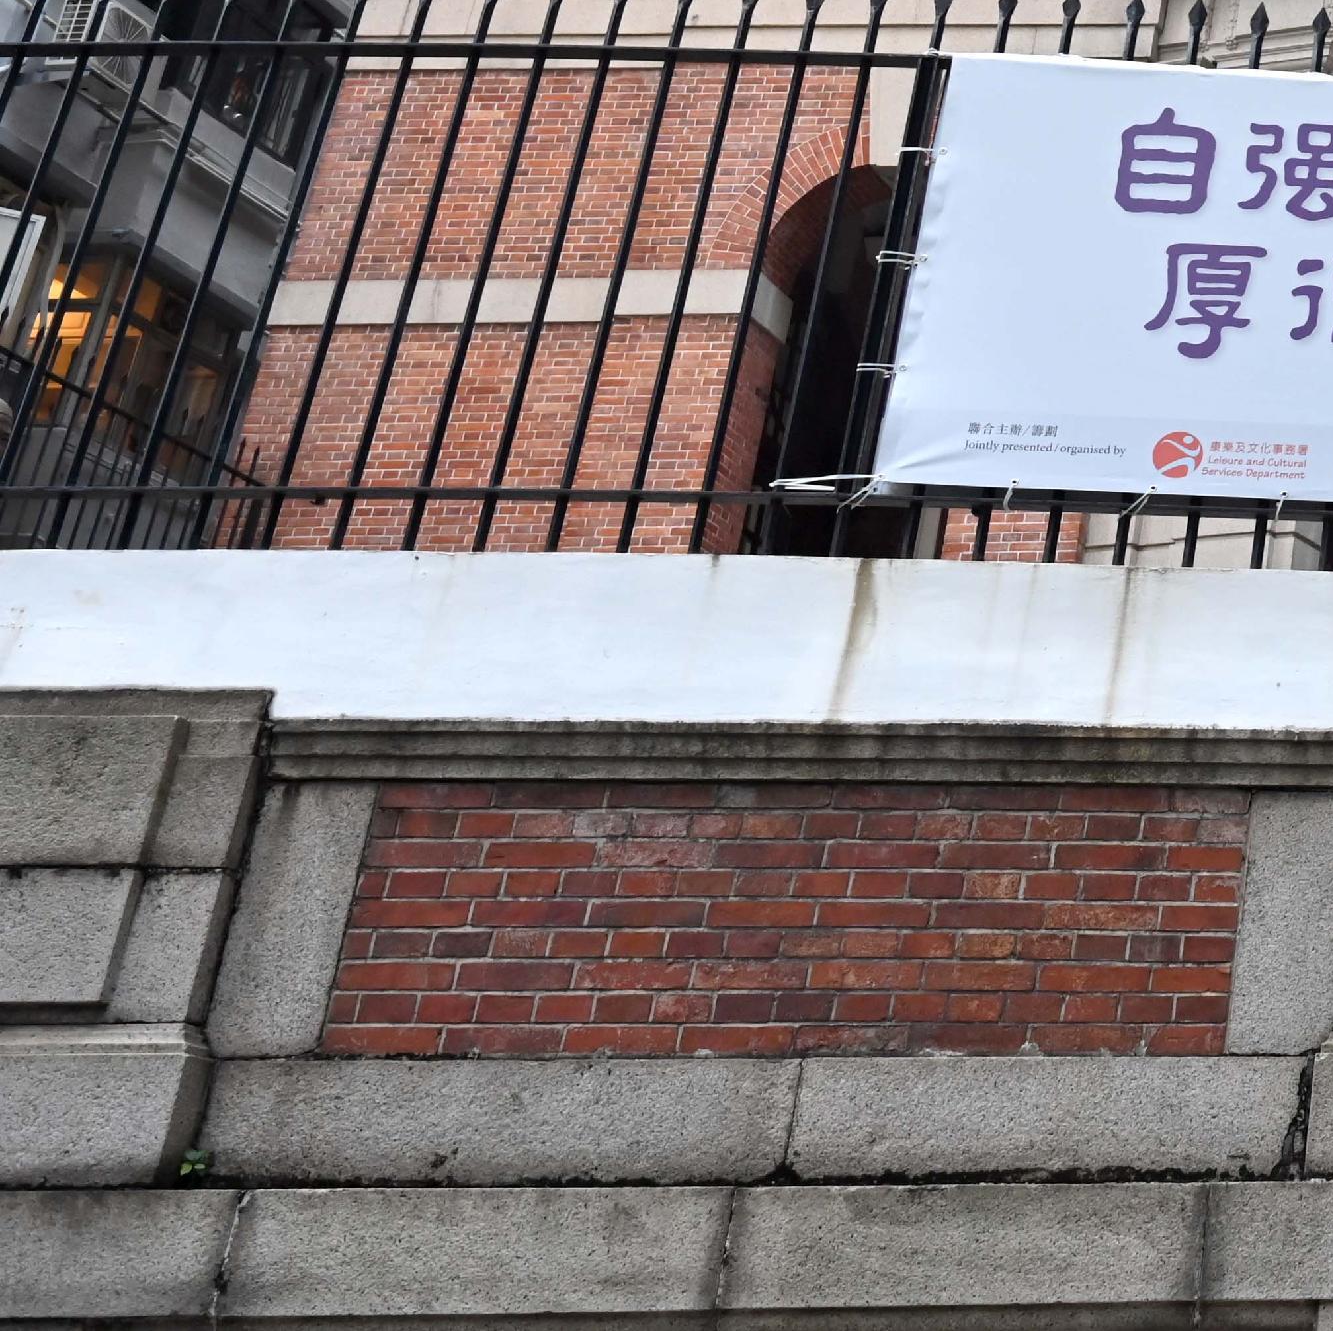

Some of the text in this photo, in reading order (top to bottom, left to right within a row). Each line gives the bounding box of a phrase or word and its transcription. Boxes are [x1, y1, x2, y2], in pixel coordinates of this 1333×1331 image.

[964, 439, 1000, 453] Jointly
[1113, 445, 1127, 458] by
[1208, 456, 1307, 468] Leisure and Cultural
[1201, 467, 1305, 481] Services Department
